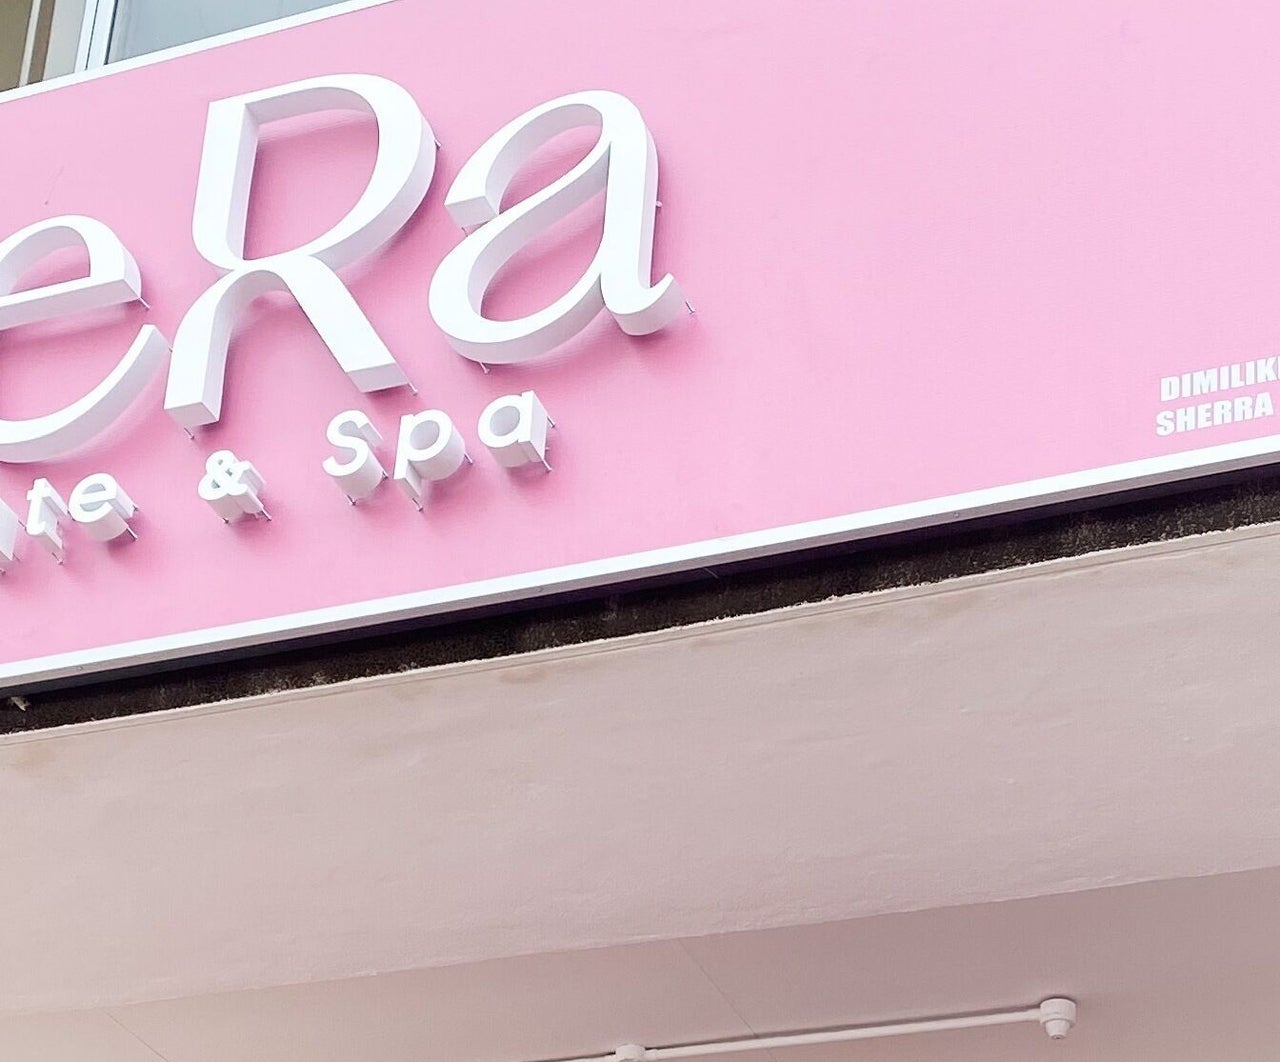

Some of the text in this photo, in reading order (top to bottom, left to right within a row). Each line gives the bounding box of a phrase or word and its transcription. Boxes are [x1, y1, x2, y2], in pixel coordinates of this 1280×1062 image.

[197, 448, 264, 520] &
[322, 389, 554, 505] Spa
[1155, 394, 1274, 437] SHERRA
